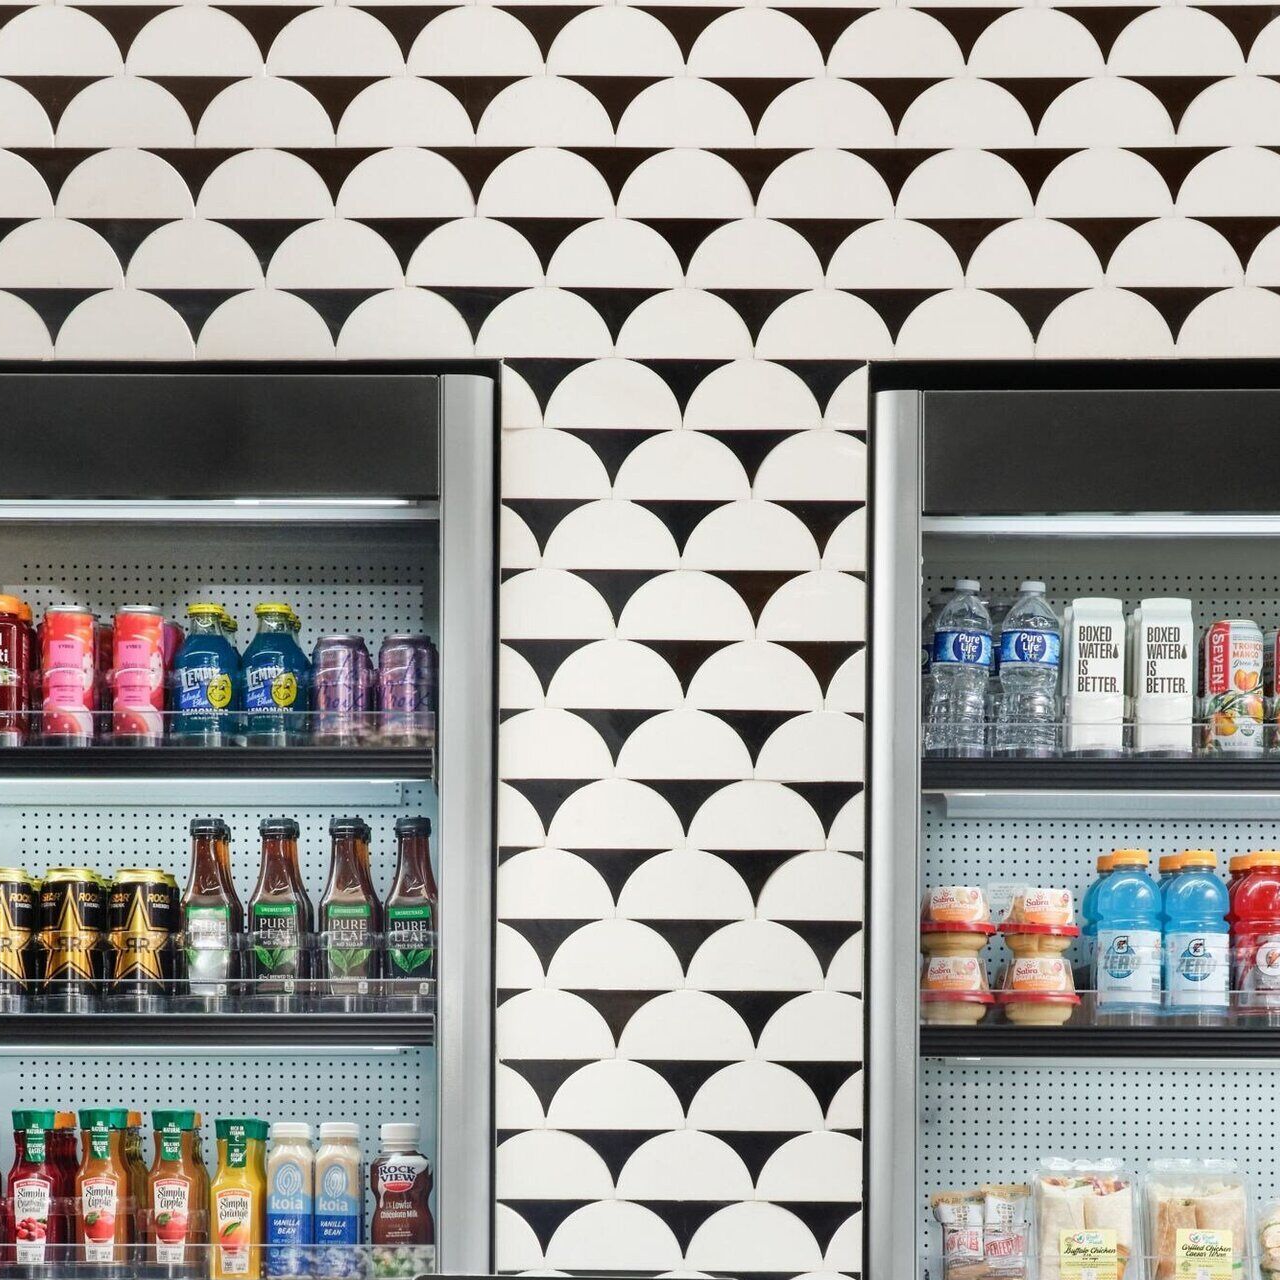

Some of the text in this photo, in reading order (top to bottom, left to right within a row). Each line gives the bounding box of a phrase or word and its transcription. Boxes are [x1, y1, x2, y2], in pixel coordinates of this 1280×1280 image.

[959, 633, 980, 644] Pure
[1021, 632, 1042, 644] Pure
[1079, 626, 1112, 642] BOXED
[1147, 627, 1180, 642] BOXED
[961, 642, 977, 652] Life
[1079, 643, 1112, 658] WATER
[1147, 644, 1180, 659] WATER
[1212, 634, 1225, 684] SEVEN
[1079, 660, 1088, 675] IS
[1146, 661, 1156, 676] IS
[1078, 677, 1119, 692] BETTER.
[1146, 678, 1188, 693] BETTER.
[259, 918, 293, 929] PURE
[332, 919, 367, 929] PURE
[394, 920, 426, 931] PURE
[260, 930, 293, 939] LEAF
[333, 931, 365, 941] LEAF
[394, 932, 425, 942] LEAF
[379, 1165, 415, 1175] ROCK
[381, 1173, 417, 1182] VIEW
[157, 1187, 186, 1199] Simply
[272, 1197, 302, 1210] koia
[273, 1219, 300, 1227] VANILLA
[278, 1227, 296, 1235] BEAN
